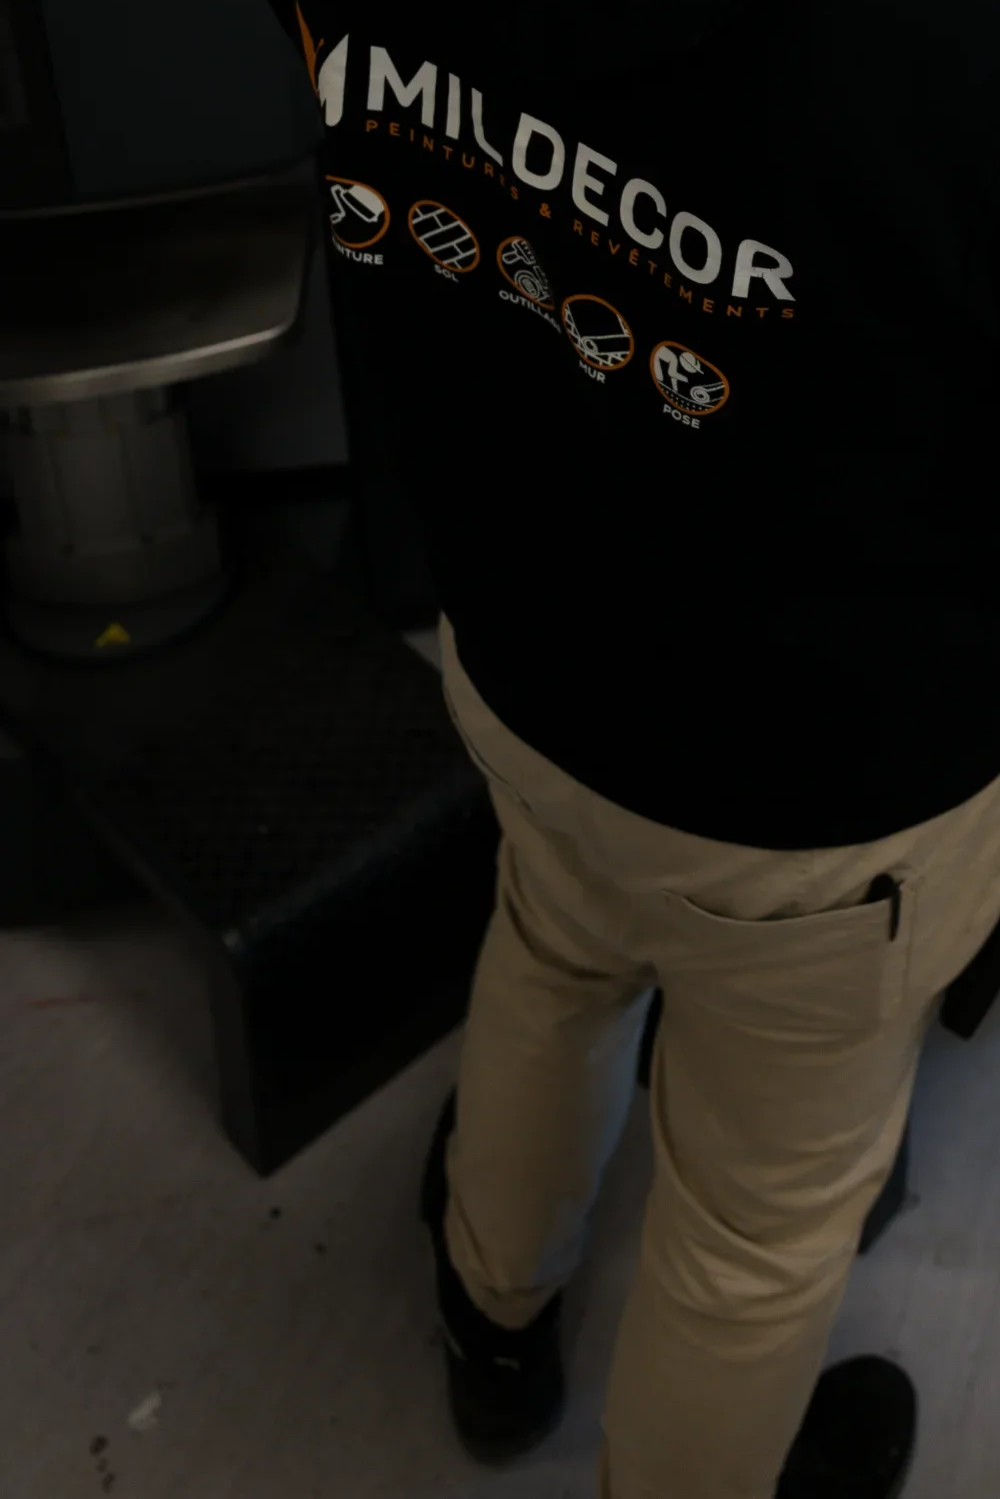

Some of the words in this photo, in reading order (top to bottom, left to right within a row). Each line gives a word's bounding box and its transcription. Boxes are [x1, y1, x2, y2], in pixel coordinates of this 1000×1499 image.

[366, 44, 796, 302] MILDECOR
[365, 118, 520, 201] PEINTURES
[539, 202, 551, 219] &
[573, 219, 795, 321] REVÊTEMENTS
[434, 263, 460, 284] SOL
[578, 359, 607, 385] MUR
[662, 403, 701, 430] POSE
